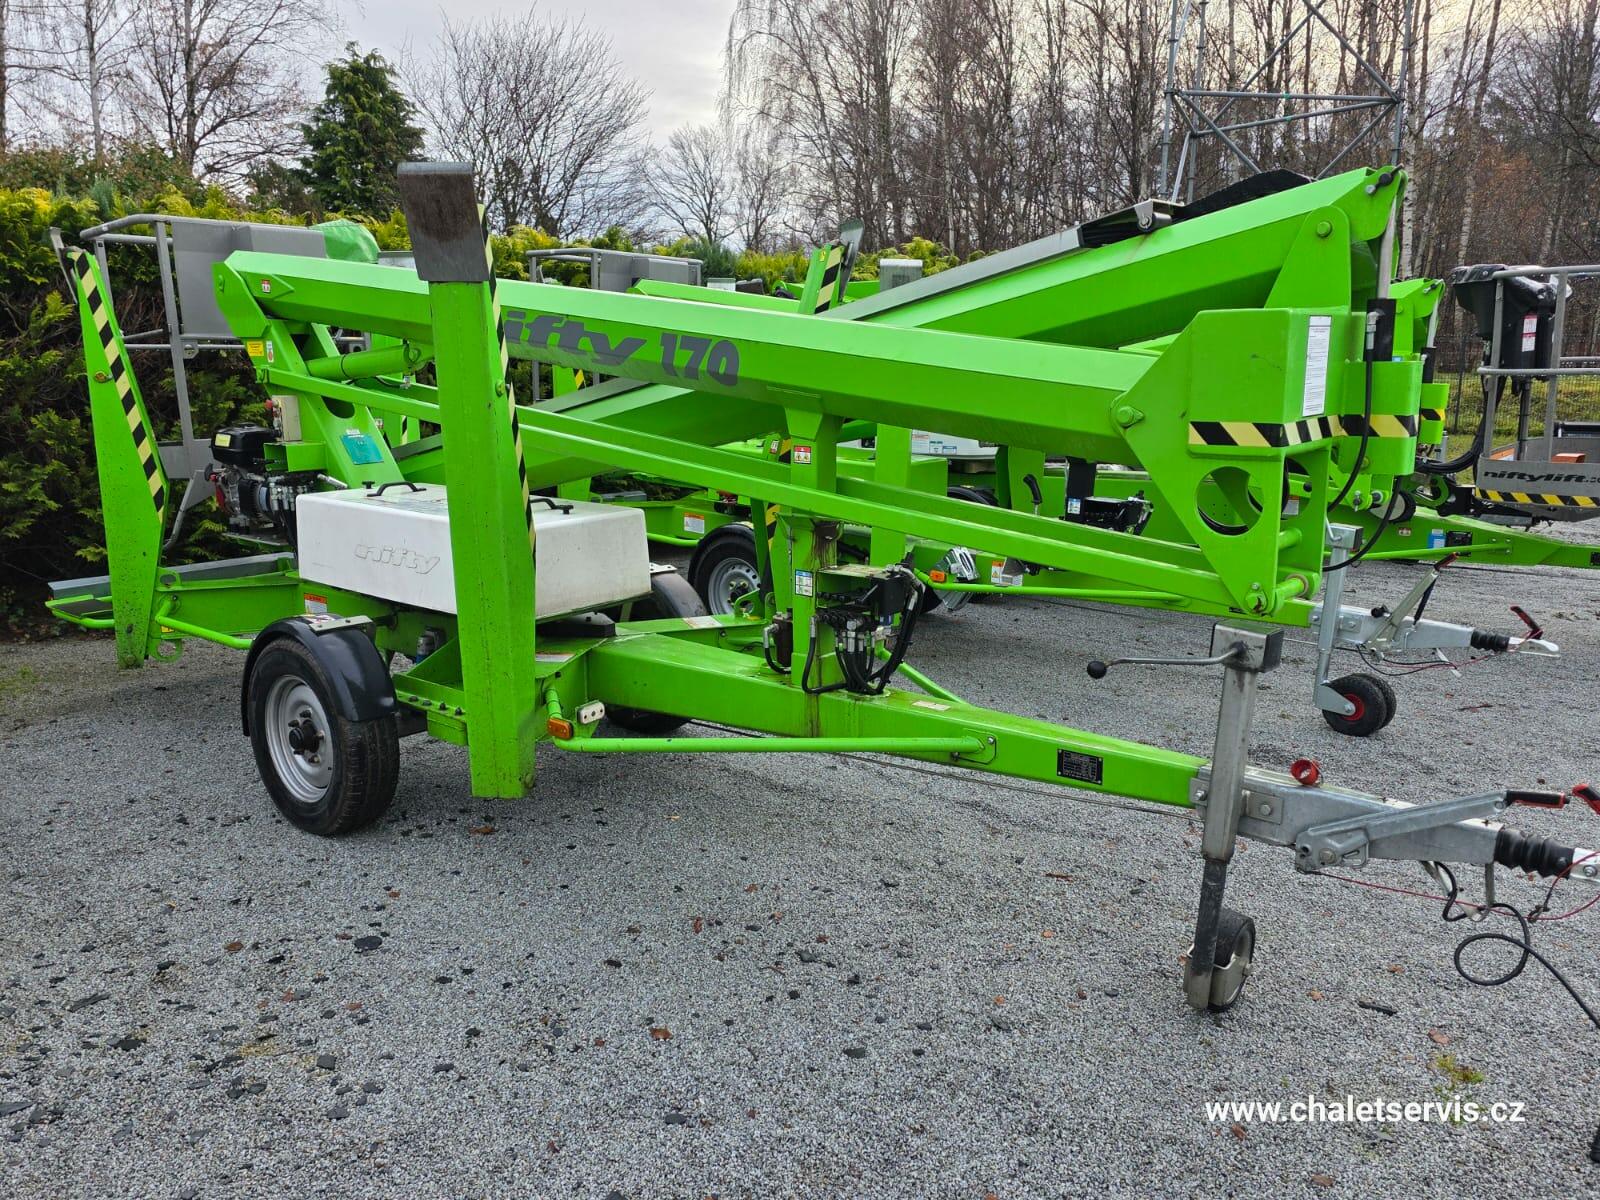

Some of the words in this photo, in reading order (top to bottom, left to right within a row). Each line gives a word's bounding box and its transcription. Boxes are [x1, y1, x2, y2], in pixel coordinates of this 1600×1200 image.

[503, 311, 648, 366] ifty
[661, 332, 740, 387] 170
[355, 544, 440, 575] nifty
